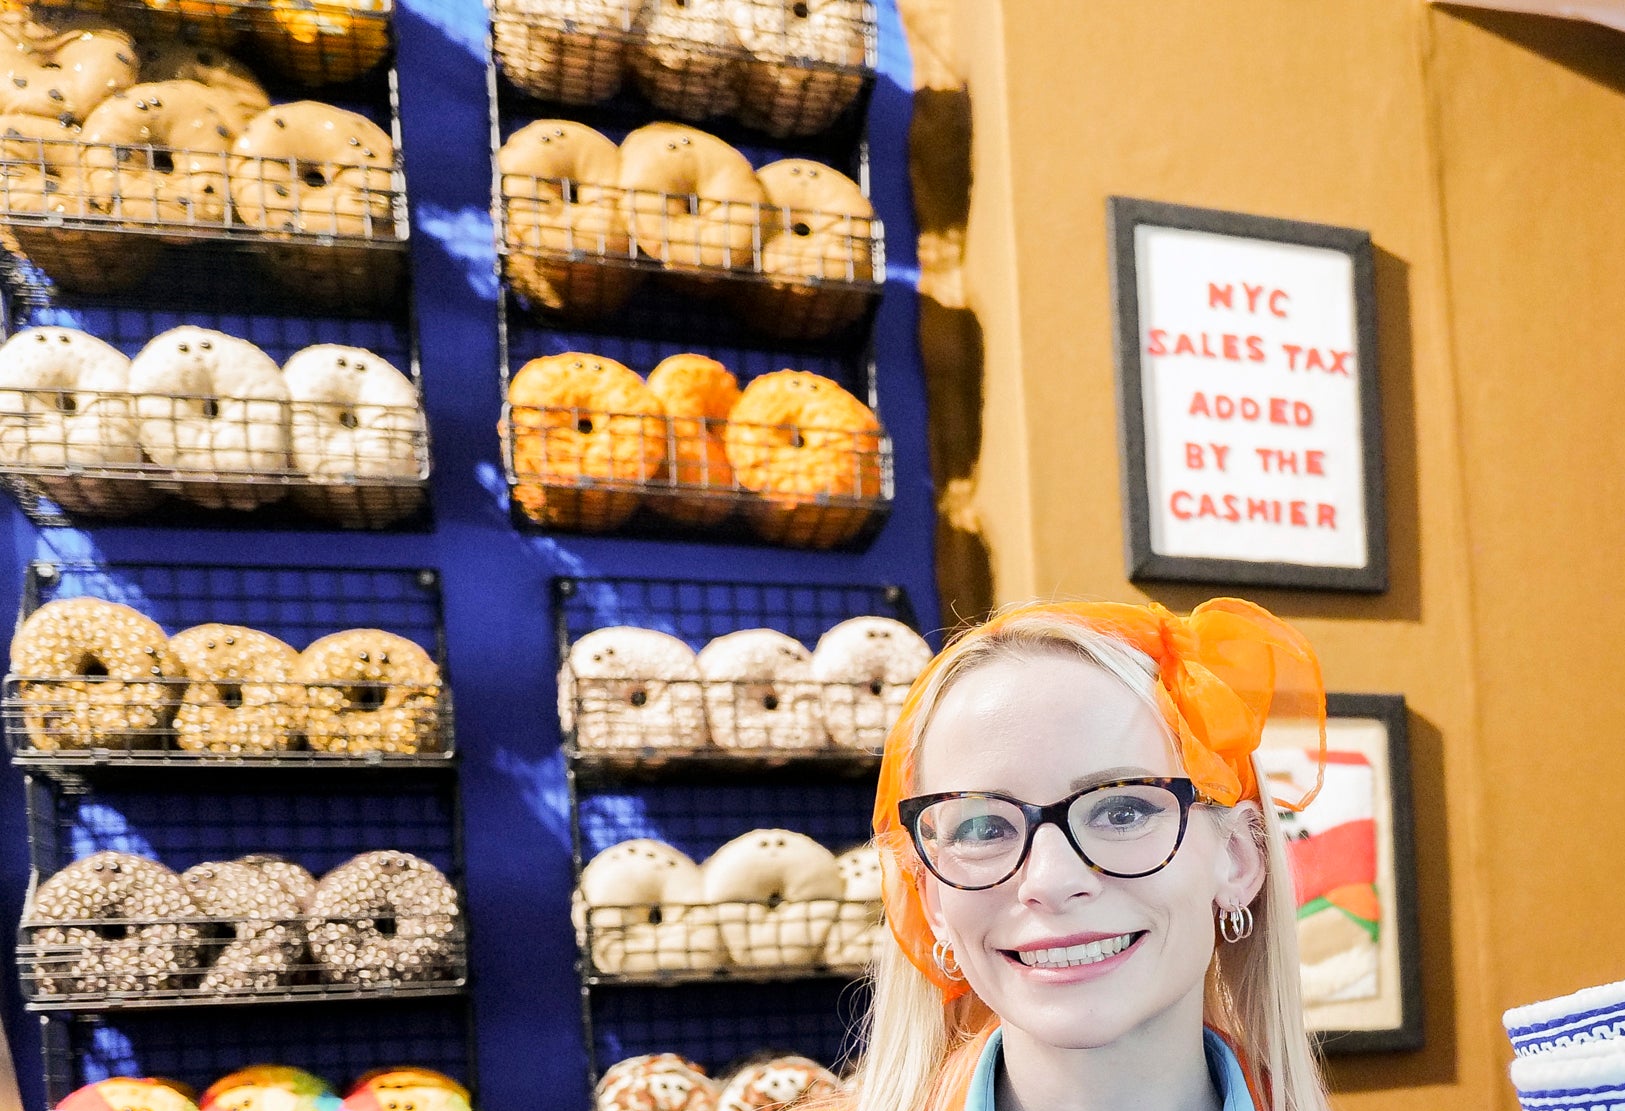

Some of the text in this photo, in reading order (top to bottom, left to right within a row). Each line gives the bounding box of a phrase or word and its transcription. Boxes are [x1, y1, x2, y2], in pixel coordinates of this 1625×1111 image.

[1208, 282, 1289, 318] NYC
[1148, 328, 1354, 377] SALES TAX
[1189, 391, 1313, 427] ADDED
[1185, 443, 1326, 476] BY THE
[1170, 490, 1336, 529] CASHIER
